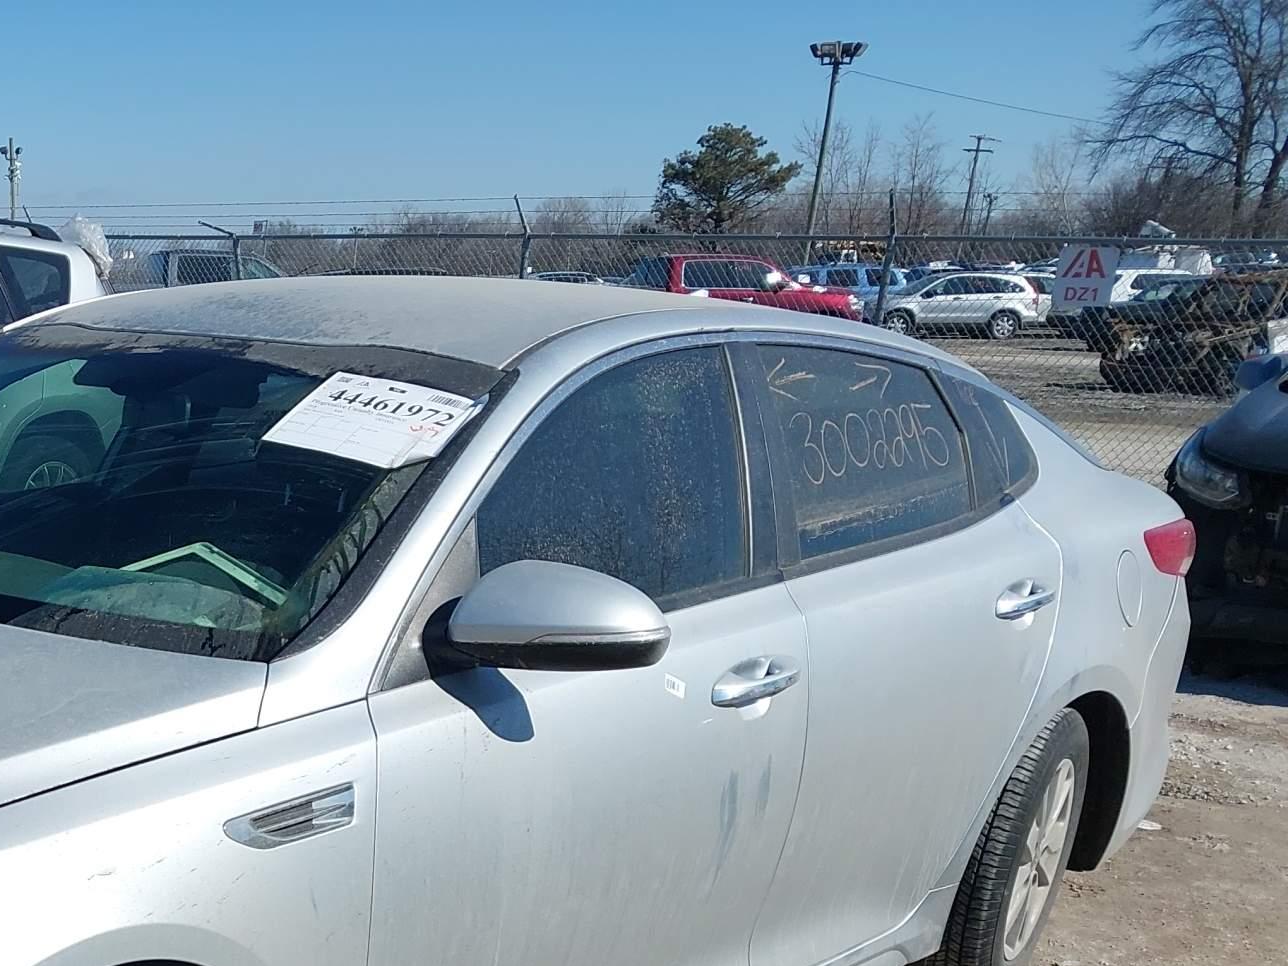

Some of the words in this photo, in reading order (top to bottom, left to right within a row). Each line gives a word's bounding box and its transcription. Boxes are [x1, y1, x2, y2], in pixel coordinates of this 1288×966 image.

[1063, 287, 1099, 302] DZ1
[328, 388, 455, 427] 44461972
[789, 403, 950, 485] 3002295
